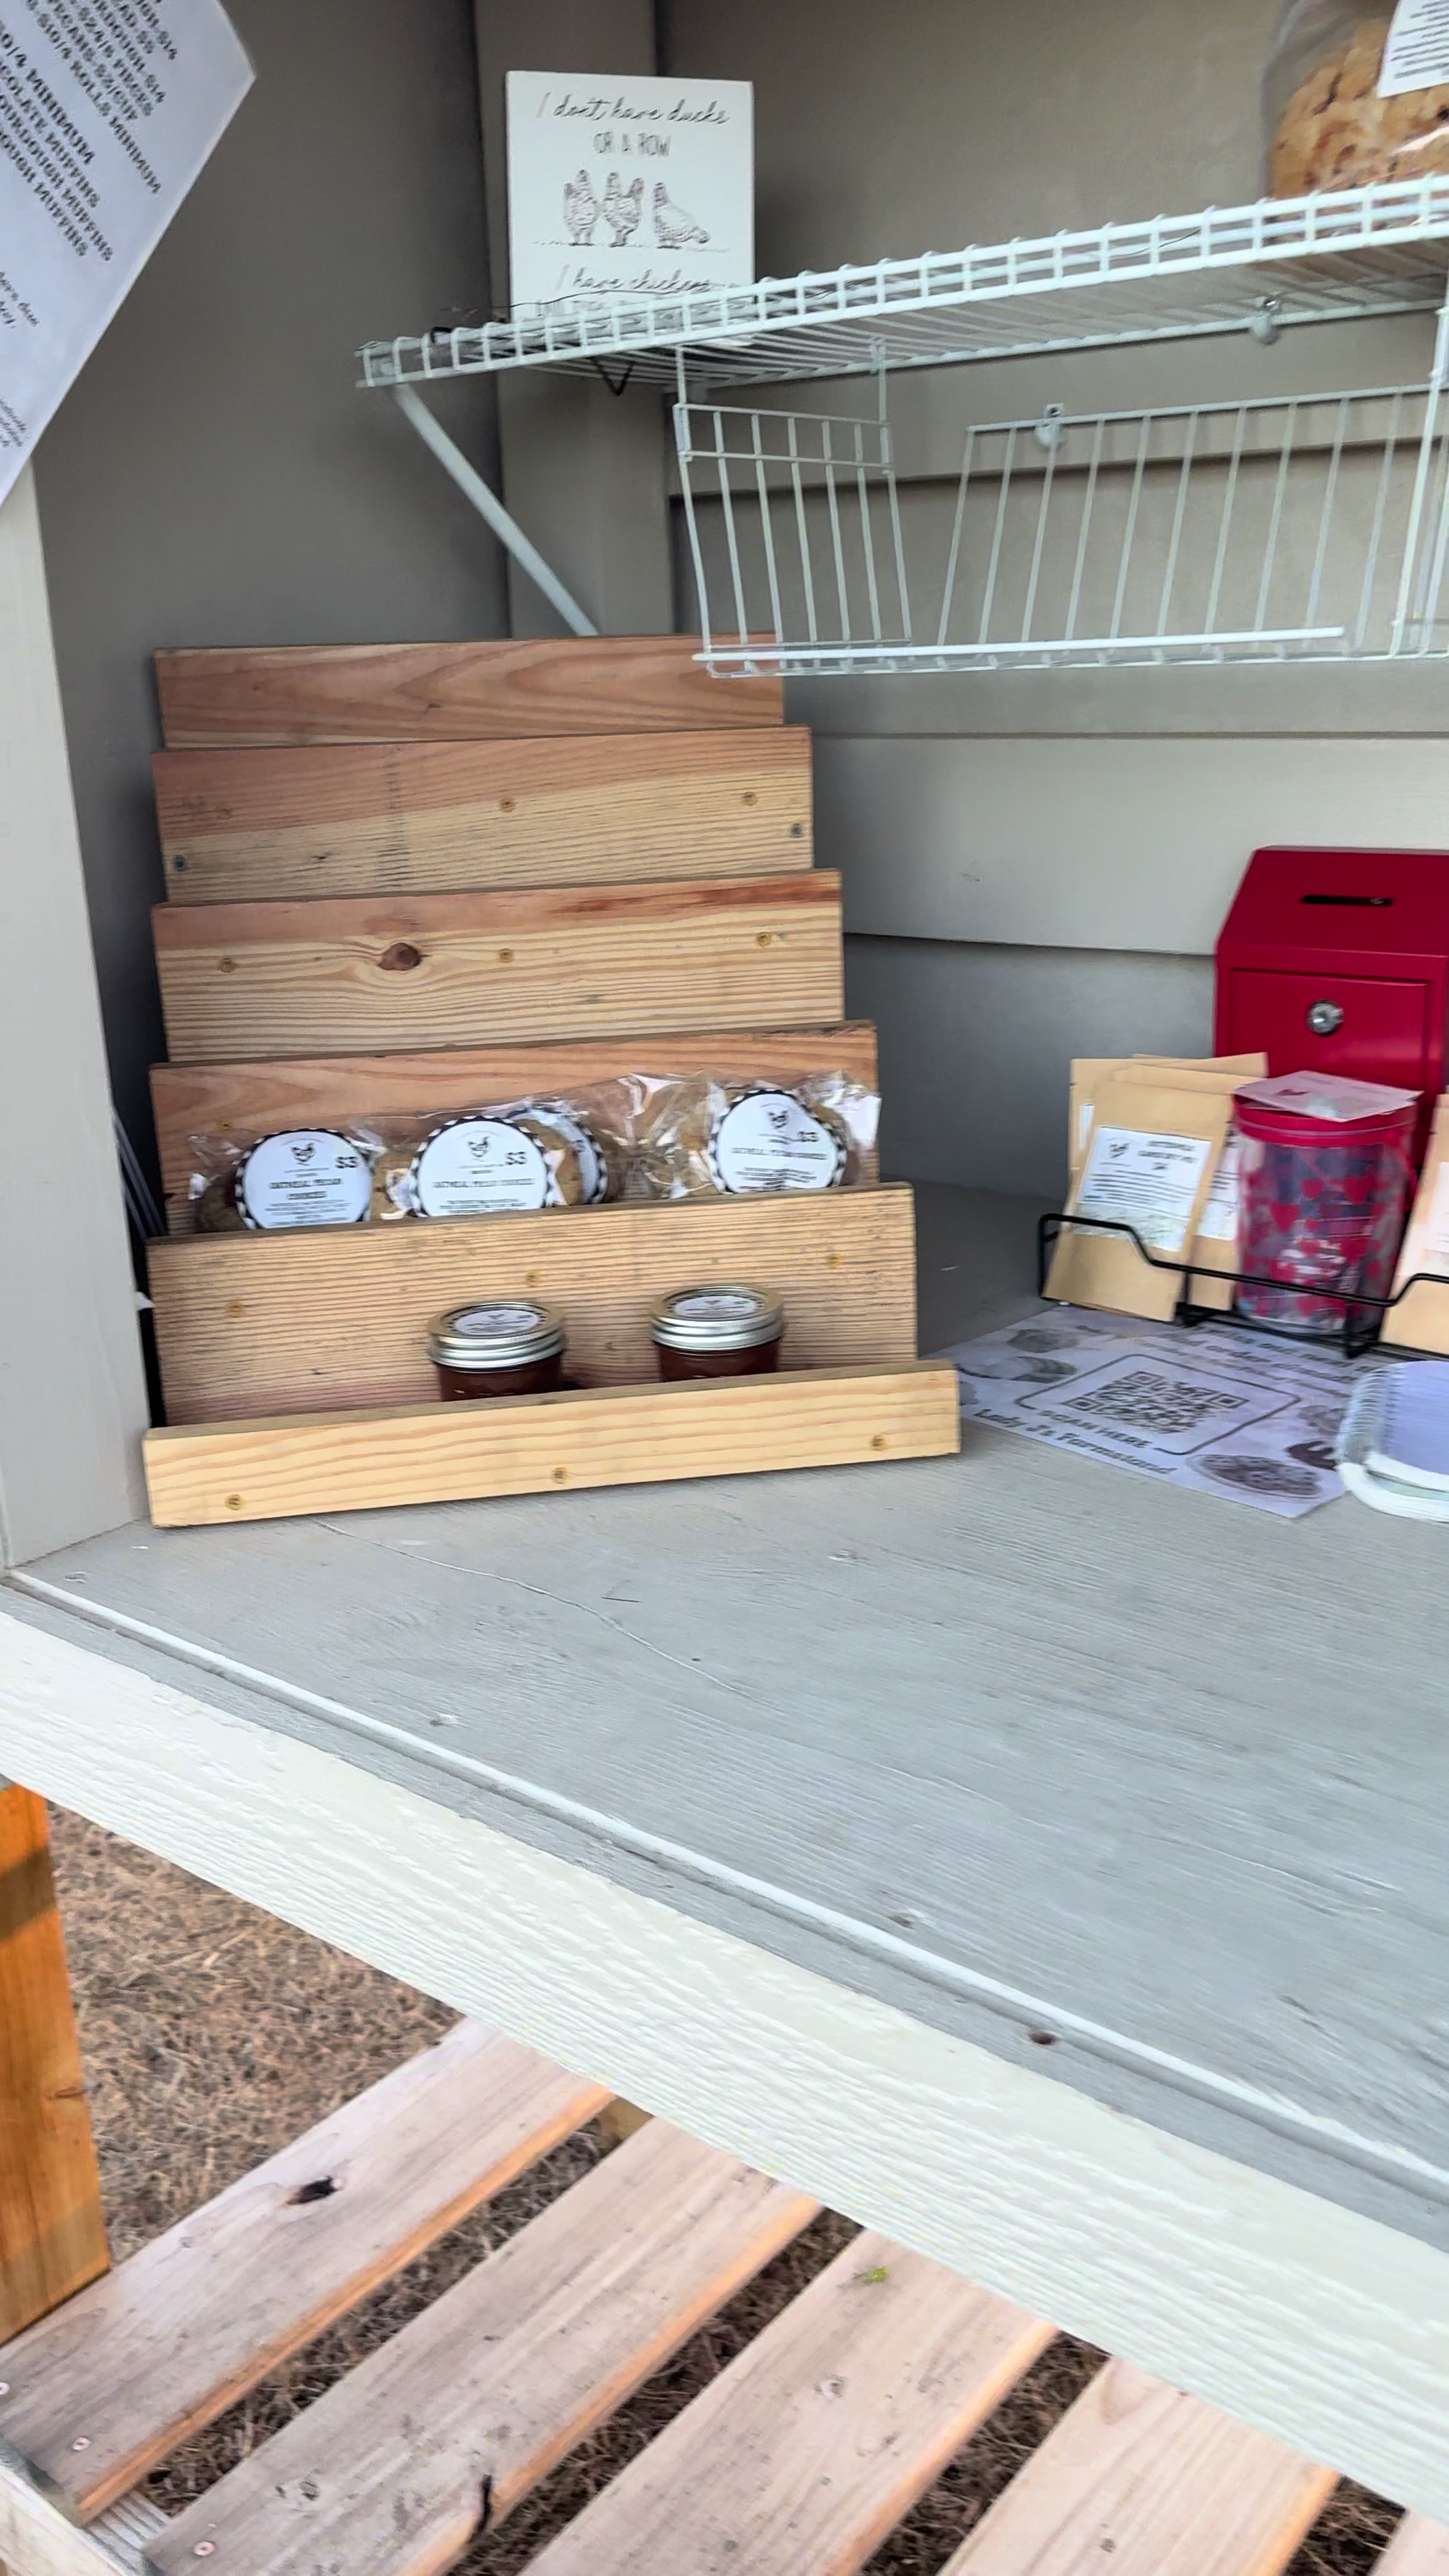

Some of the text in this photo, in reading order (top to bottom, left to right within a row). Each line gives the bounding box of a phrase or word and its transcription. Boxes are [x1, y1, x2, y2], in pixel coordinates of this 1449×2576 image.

[25, 68, 96, 165] MINIMUM
[610, 96, 663, 121] have
[667, 98, 731, 124] ducks
[44, 131, 100, 209] MUFFINS
[109, 115, 162, 195] MINIMUM
[34, 180, 89, 257] MUFFINS
[61, 186, 113, 262] MUFFINS
[1036, 1410, 1153, 1448] SCAN HERE
